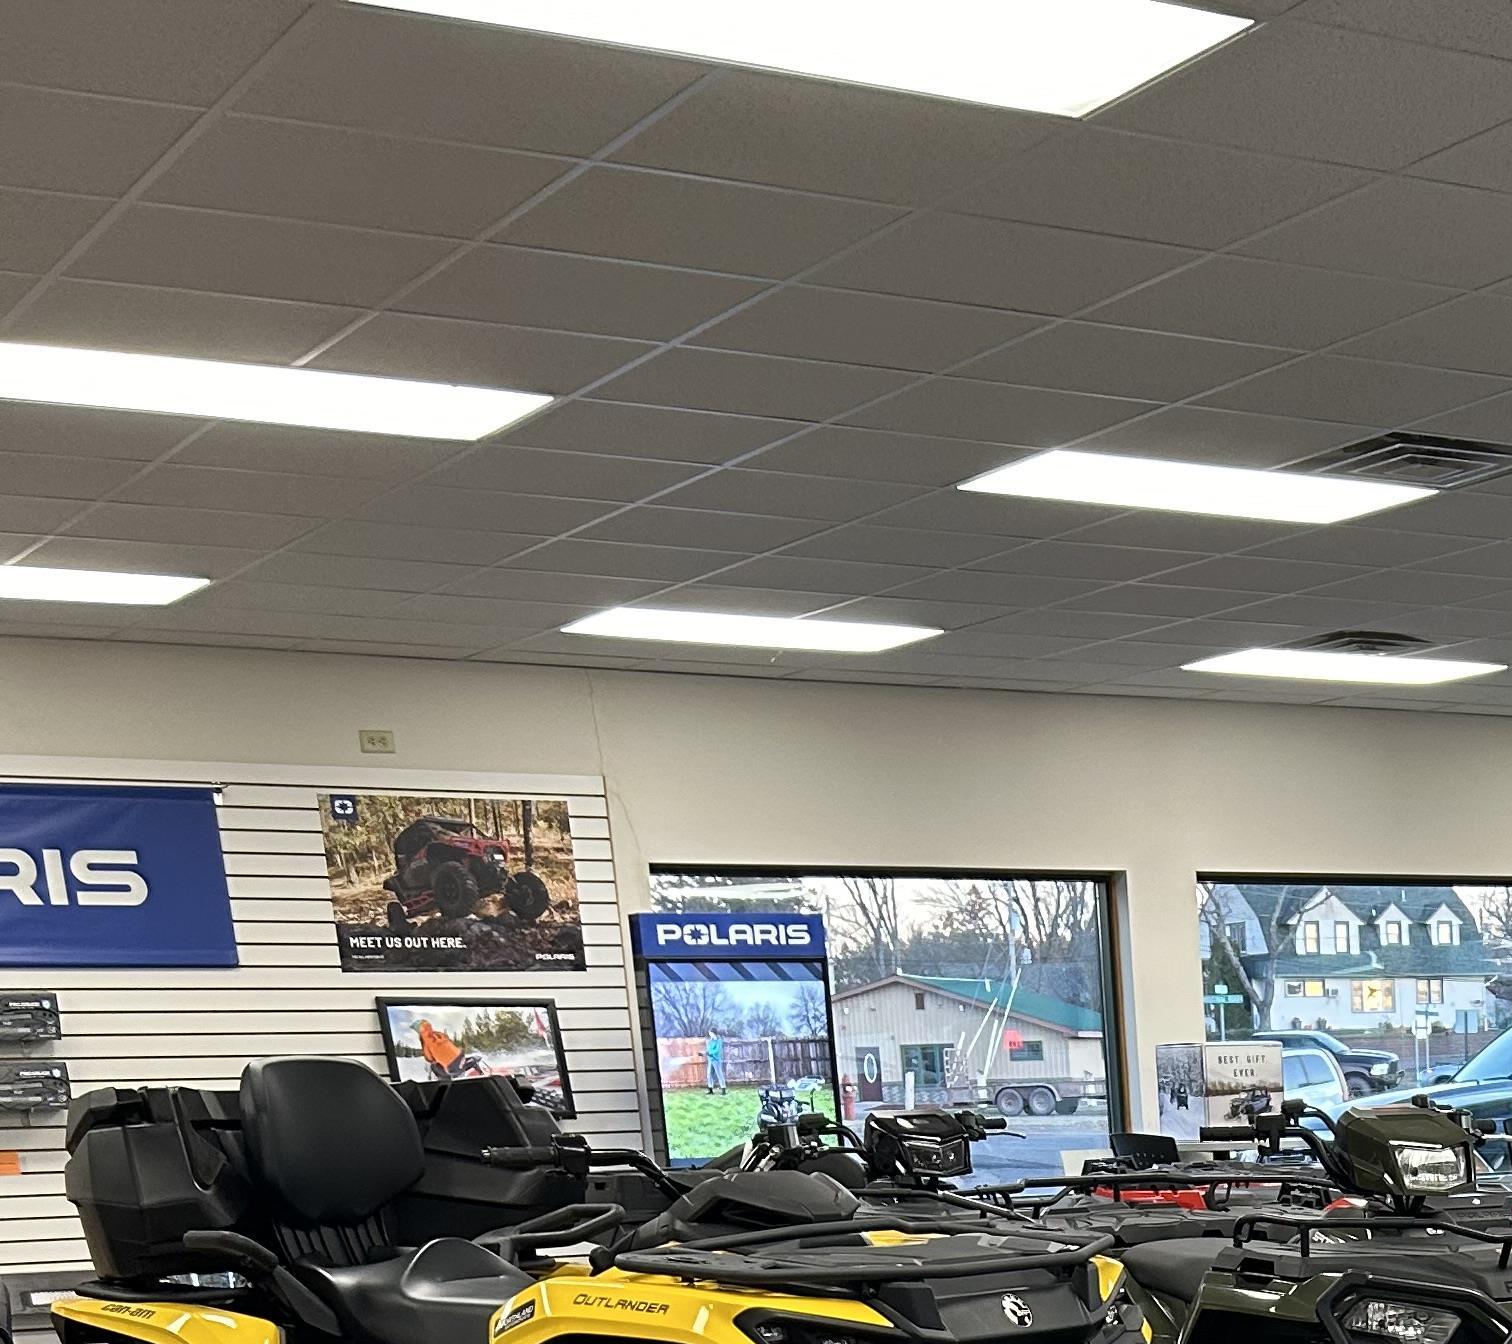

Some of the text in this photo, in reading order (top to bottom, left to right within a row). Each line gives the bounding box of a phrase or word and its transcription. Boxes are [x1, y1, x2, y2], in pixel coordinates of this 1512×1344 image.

[350, 937, 467, 948] MEET US OUT HERE.
[656, 924, 811, 945] POLARIS
[1217, 1055, 1240, 1065] BEST
[101, 1303, 155, 1319] can-am
[573, 1294, 670, 1316] OUTLANDER
